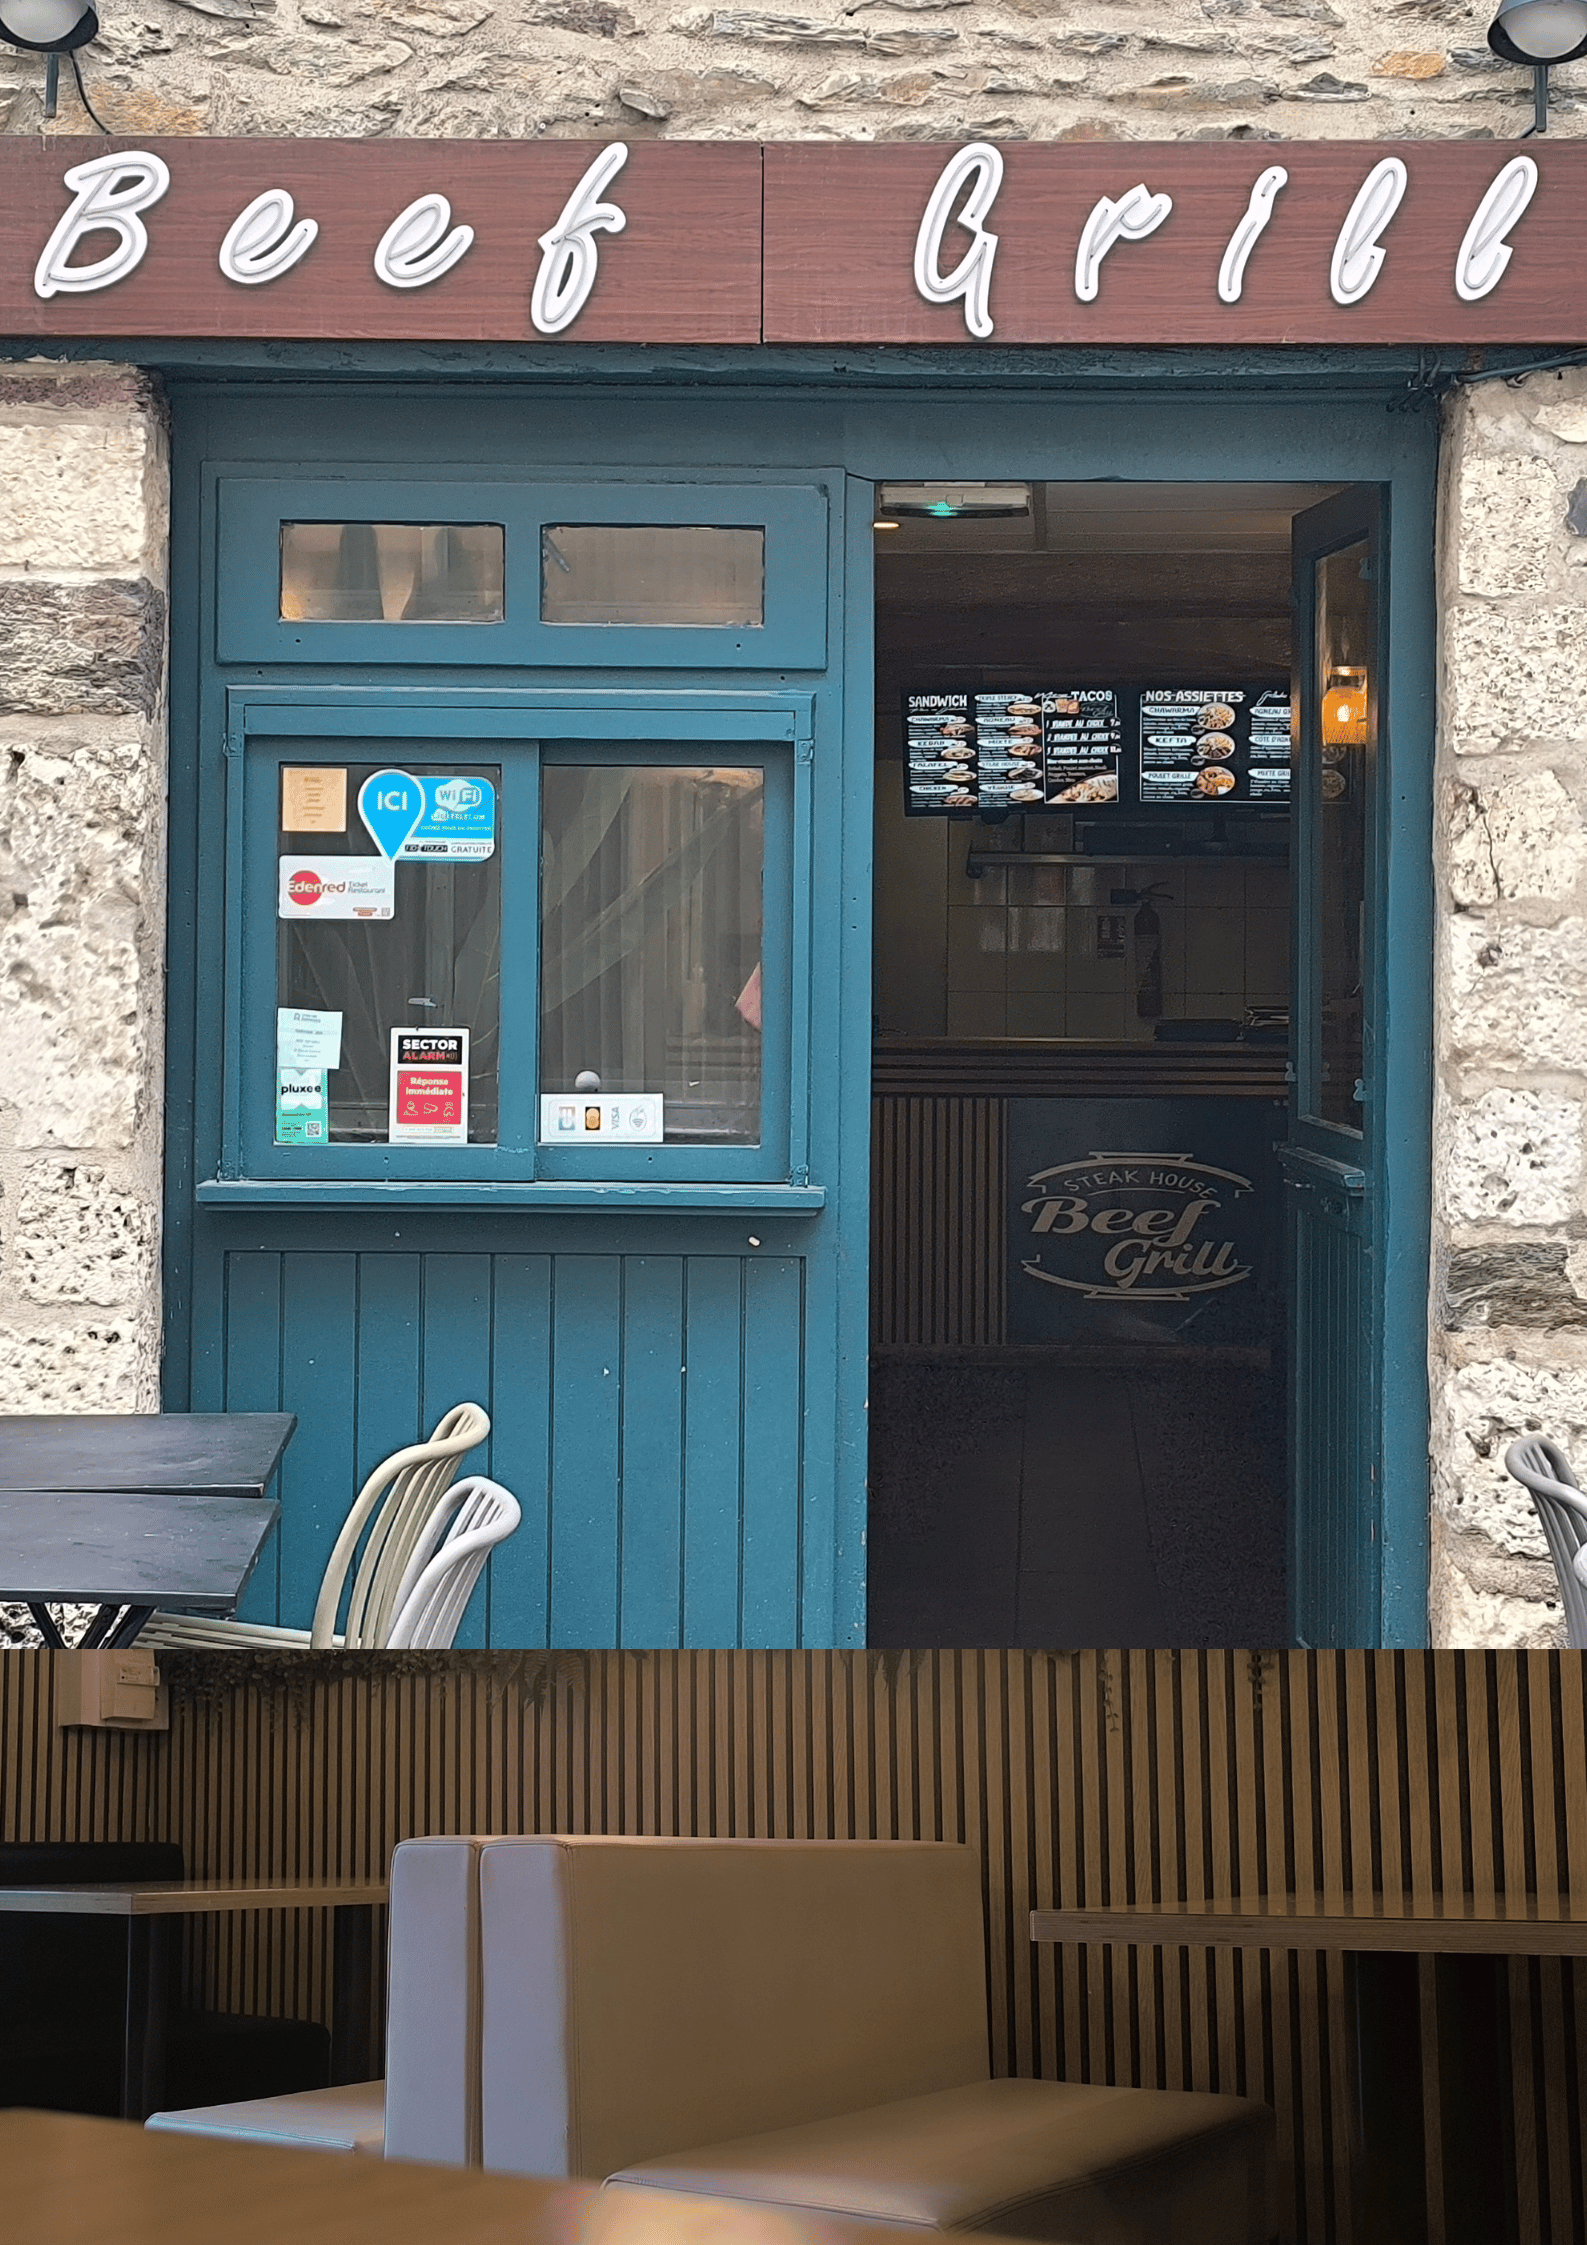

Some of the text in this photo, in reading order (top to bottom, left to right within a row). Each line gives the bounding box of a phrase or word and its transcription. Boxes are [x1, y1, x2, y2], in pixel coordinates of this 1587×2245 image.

[34, 142, 1538, 337] Beef Grill
[908, 694, 967, 707] SANDWICH
[1071, 690, 1113, 701] TACOS
[1145, 690, 1172, 702] NOS
[1176, 690, 1244, 702] ASSIETTES
[377, 791, 408, 811] ICI
[450, 845, 493, 854] GRATUITE
[287, 880, 346, 893] Edenred
[402, 1038, 458, 1051] SECTOR
[402, 1051, 446, 1061] ALARM
[409, 1076, 449, 1086] Réponse
[281, 1083, 322, 1096] pluxee
[1064, 1170, 1218, 1199] STEAK HOUSE
[1021, 1196, 1222, 1247] Beef
[1104, 1239, 1238, 1290] Grill
